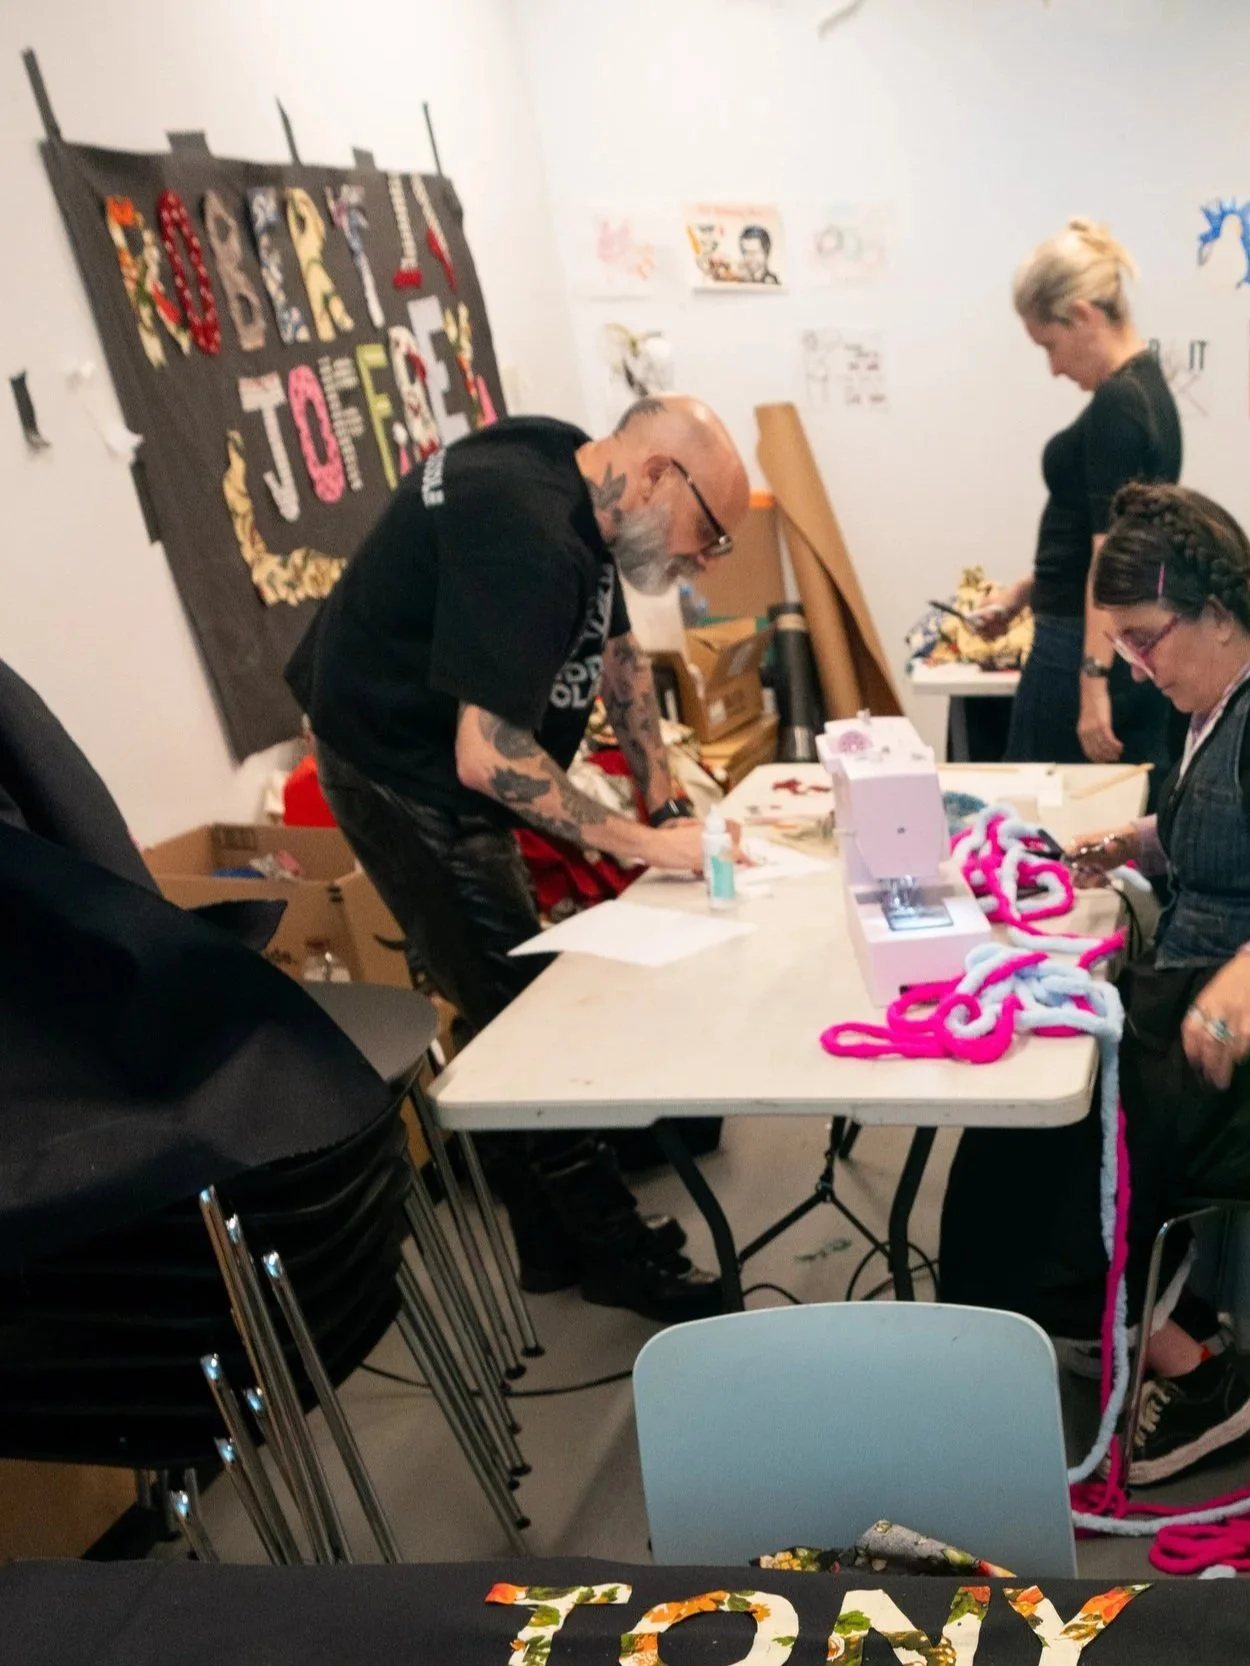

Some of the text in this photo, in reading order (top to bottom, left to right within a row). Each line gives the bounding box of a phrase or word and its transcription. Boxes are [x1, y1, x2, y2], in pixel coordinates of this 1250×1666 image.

[106, 184, 386, 369] ROBERT
[238, 295, 487, 522] JOFFREY
[485, 1583, 1155, 1666] TONY
